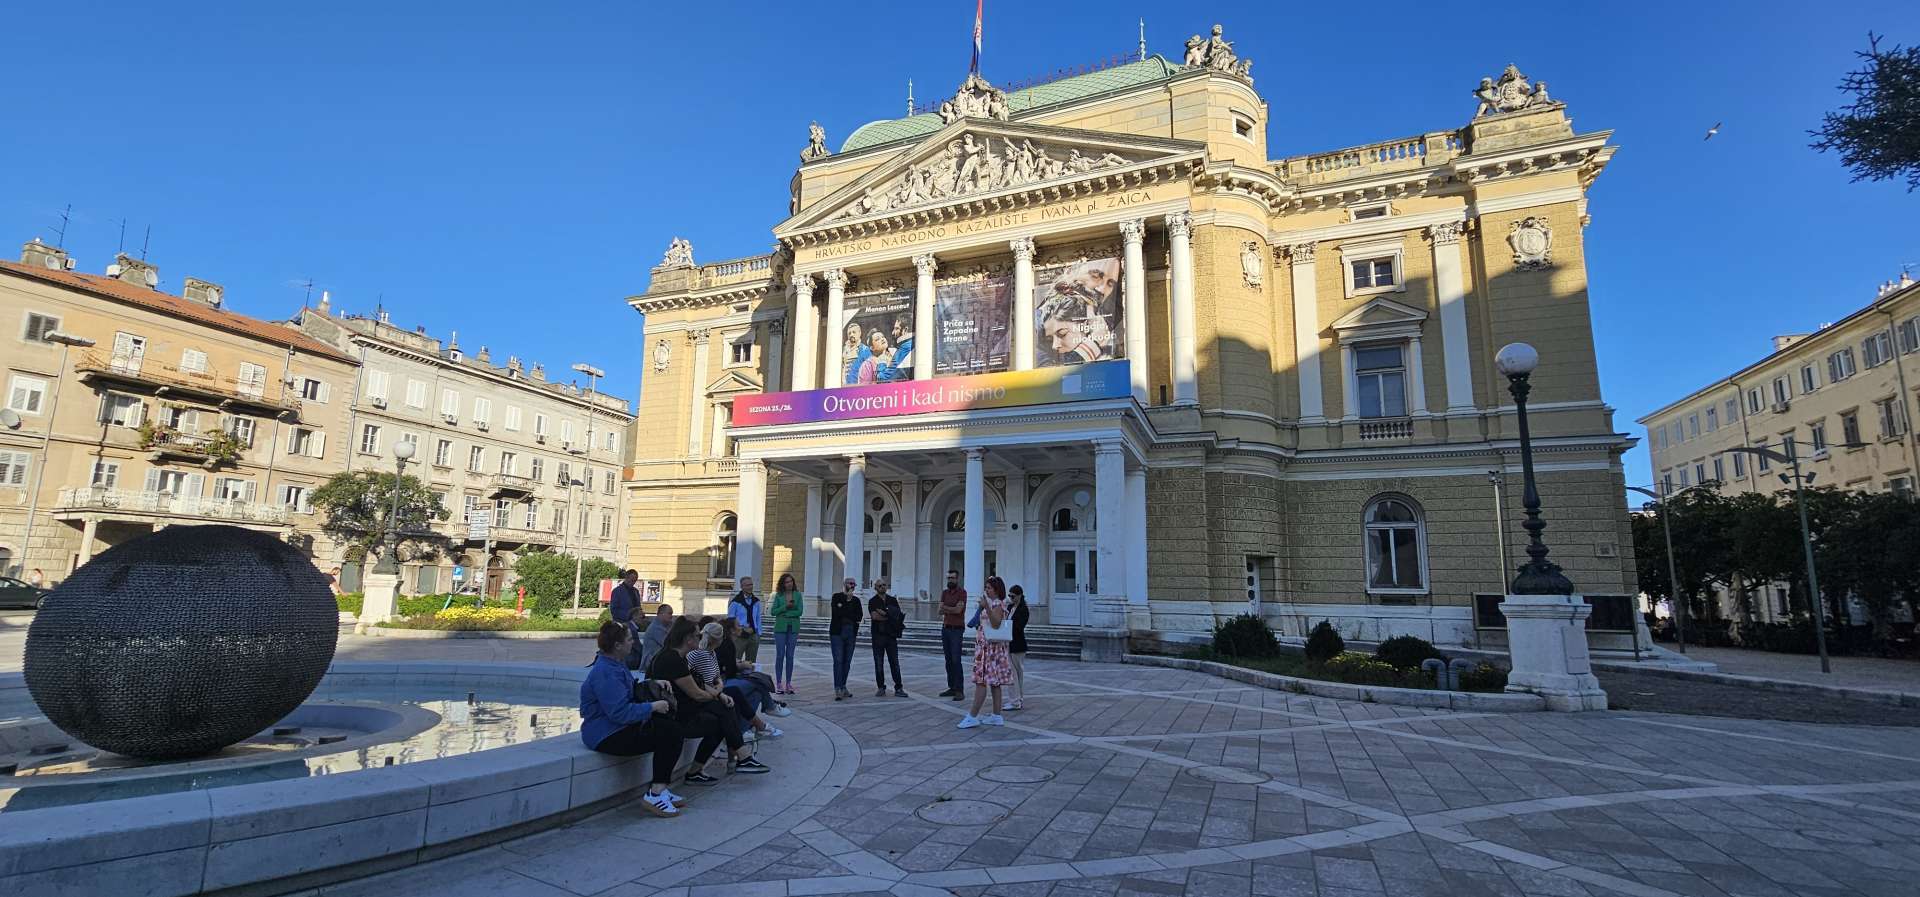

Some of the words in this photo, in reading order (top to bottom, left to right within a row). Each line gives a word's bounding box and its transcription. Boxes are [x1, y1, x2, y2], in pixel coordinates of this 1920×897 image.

[815, 241, 872, 259] HRVATSKO
[881, 227, 946, 248] NARODNO
[1041, 203, 1081, 220] IVANA
[1107, 192, 1152, 208] ZAJCA
[943, 326, 979, 336] Zapadne
[943, 335, 968, 343] strane
[823, 389, 899, 413] Otvoreni
[902, 389, 907, 407] i
[911, 385, 943, 406] kad
[948, 384, 1005, 403] nismo
[749, 405, 771, 413] SEZONA
